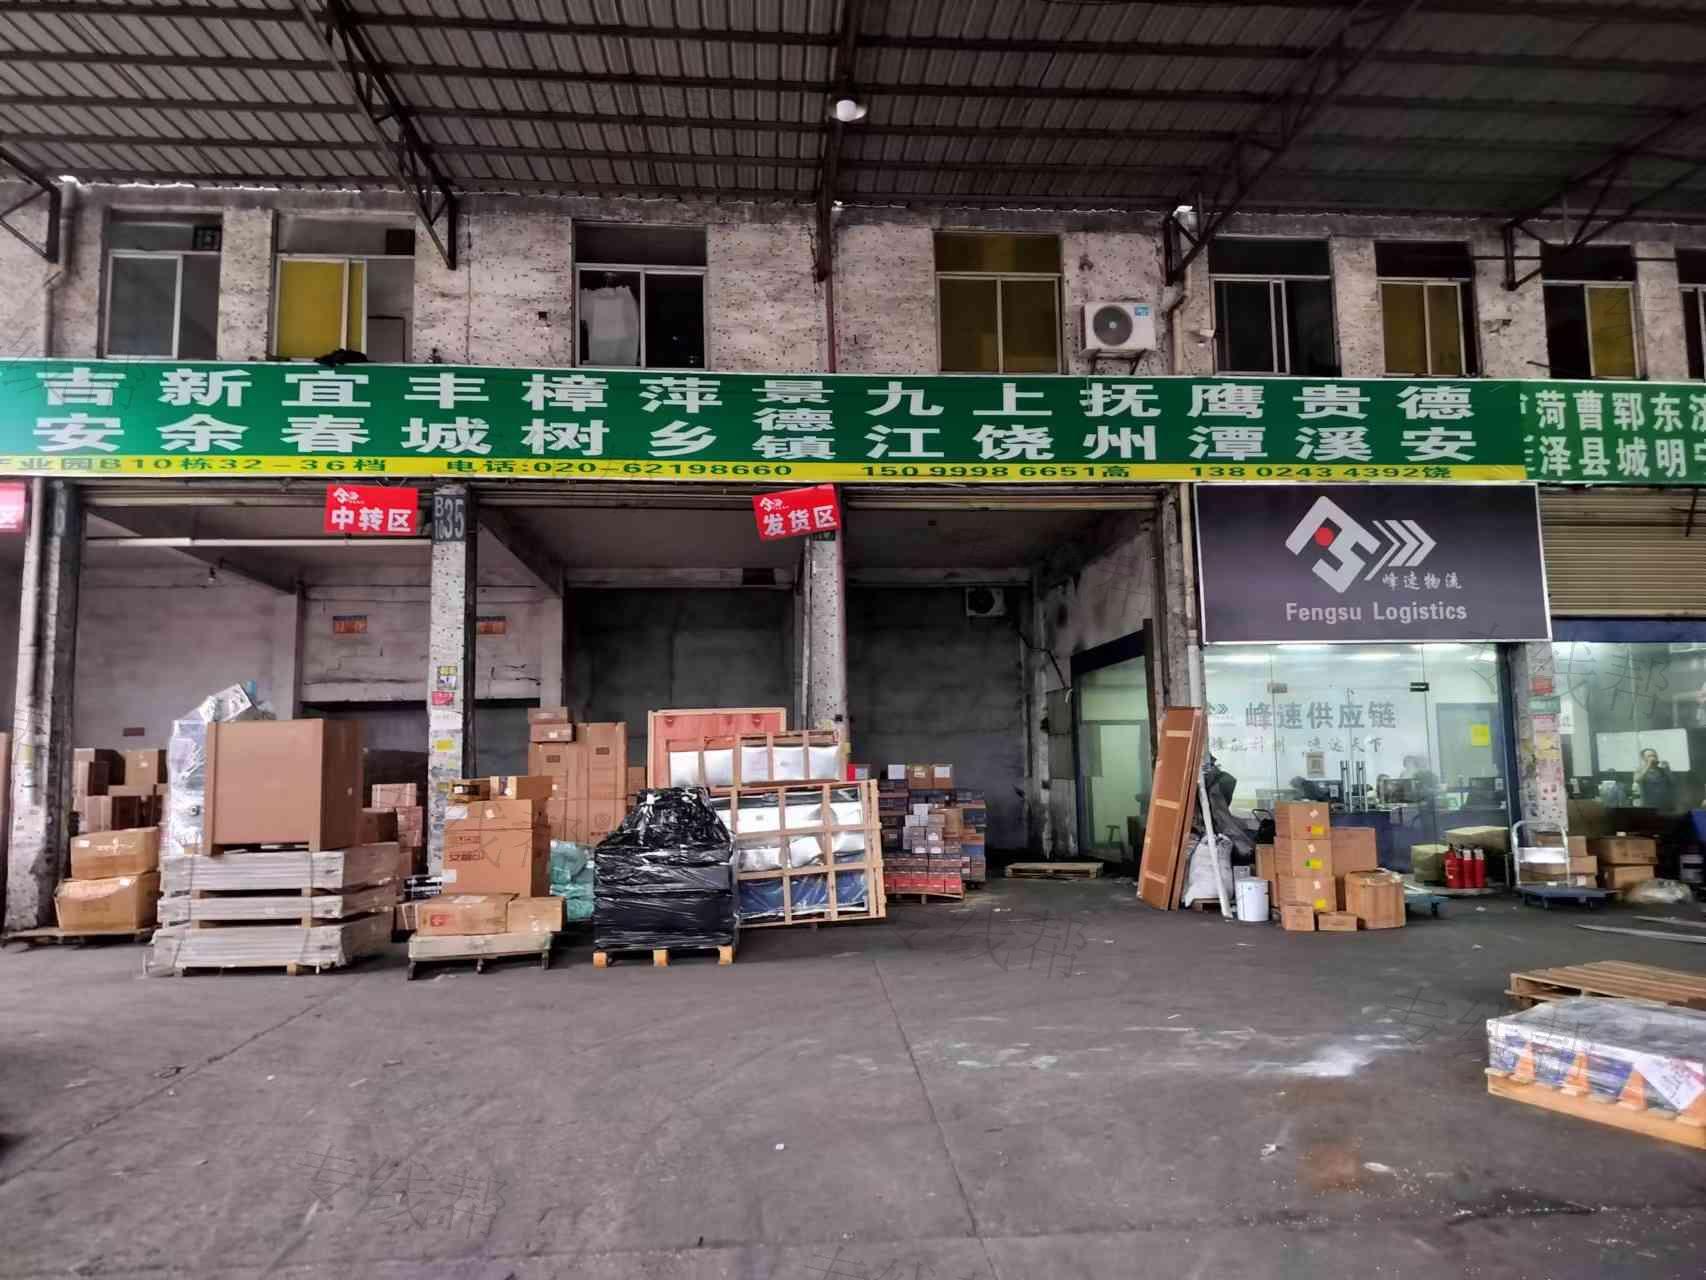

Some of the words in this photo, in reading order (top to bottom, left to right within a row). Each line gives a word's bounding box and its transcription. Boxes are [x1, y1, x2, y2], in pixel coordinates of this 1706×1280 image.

[33, 367, 126, 453] 吉安
[157, 368, 252, 453] 新余
[281, 369, 371, 453] 宜春
[401, 372, 493, 454] 丰城
[521, 374, 610, 456] 樟树
[639, 376, 722, 457] 萍乡
[752, 379, 837, 459] 景德镇
[864, 381, 945, 459] 九江
[972, 382, 1055, 460] 上饶
[1079, 382, 1161, 461] 抚州
[1186, 383, 1268, 461] 鹰潭
[1293, 384, 1373, 462] 贵溪
[1397, 384, 1476, 462] 德安
[1535, 389, 1572, 477] 菏泽
[1573, 389, 1610, 477] 曹县
[1651, 391, 1687, 478] 东明
[331, 506, 411, 532] 中转区
[763, 505, 837, 536] 发货区
[1286, 602, 1362, 625] Fengsu
[1373, 602, 1468, 625] Logistics
[1245, 701, 1397, 729] 峰速供应链
